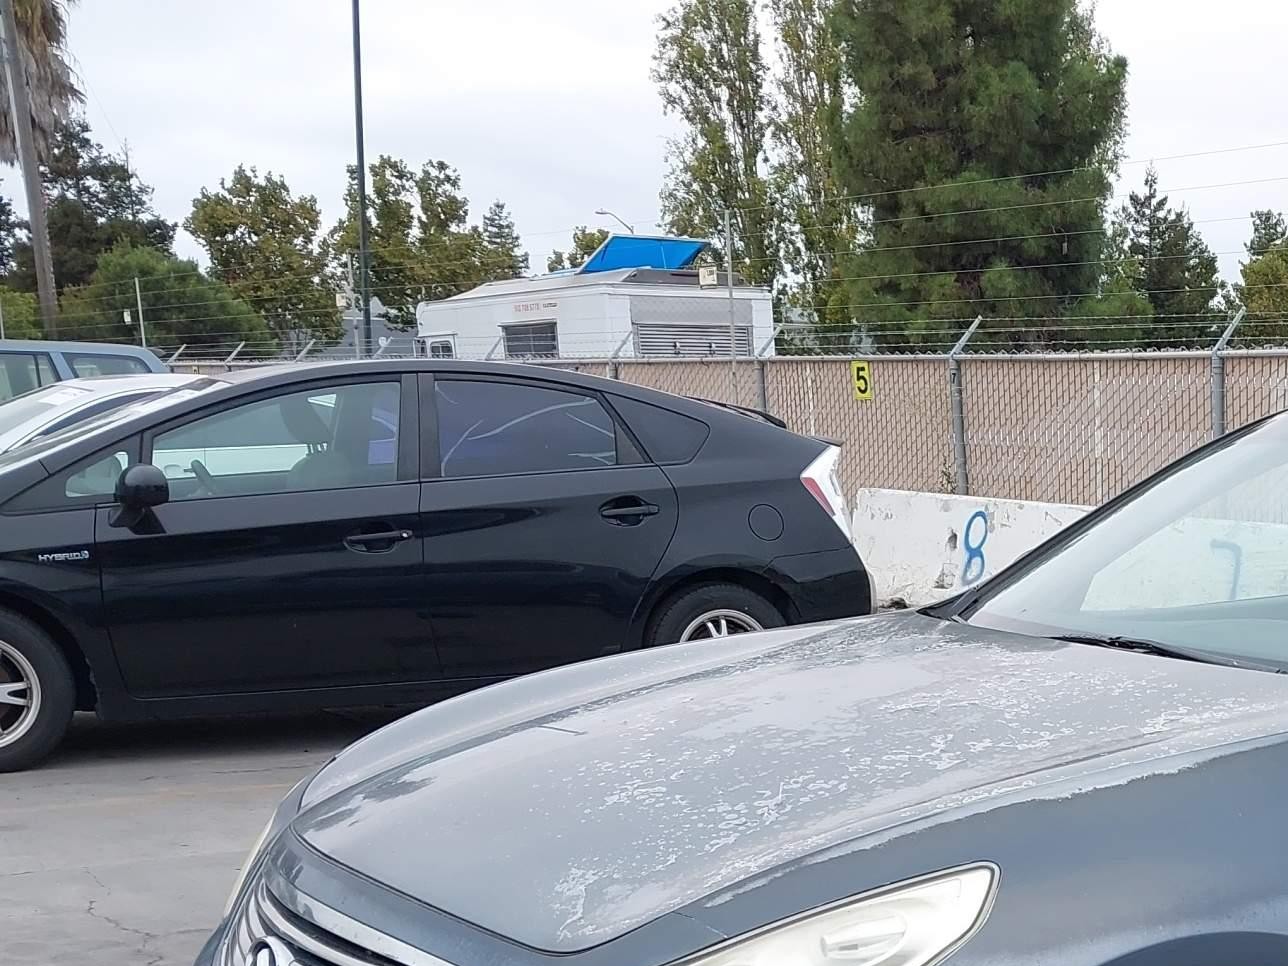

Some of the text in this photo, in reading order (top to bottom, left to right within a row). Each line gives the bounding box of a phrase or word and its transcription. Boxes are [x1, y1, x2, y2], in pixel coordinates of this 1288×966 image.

[856, 366, 868, 394] 5
[38, 552, 82, 561] HYBRID
[962, 510, 988, 586] 8
